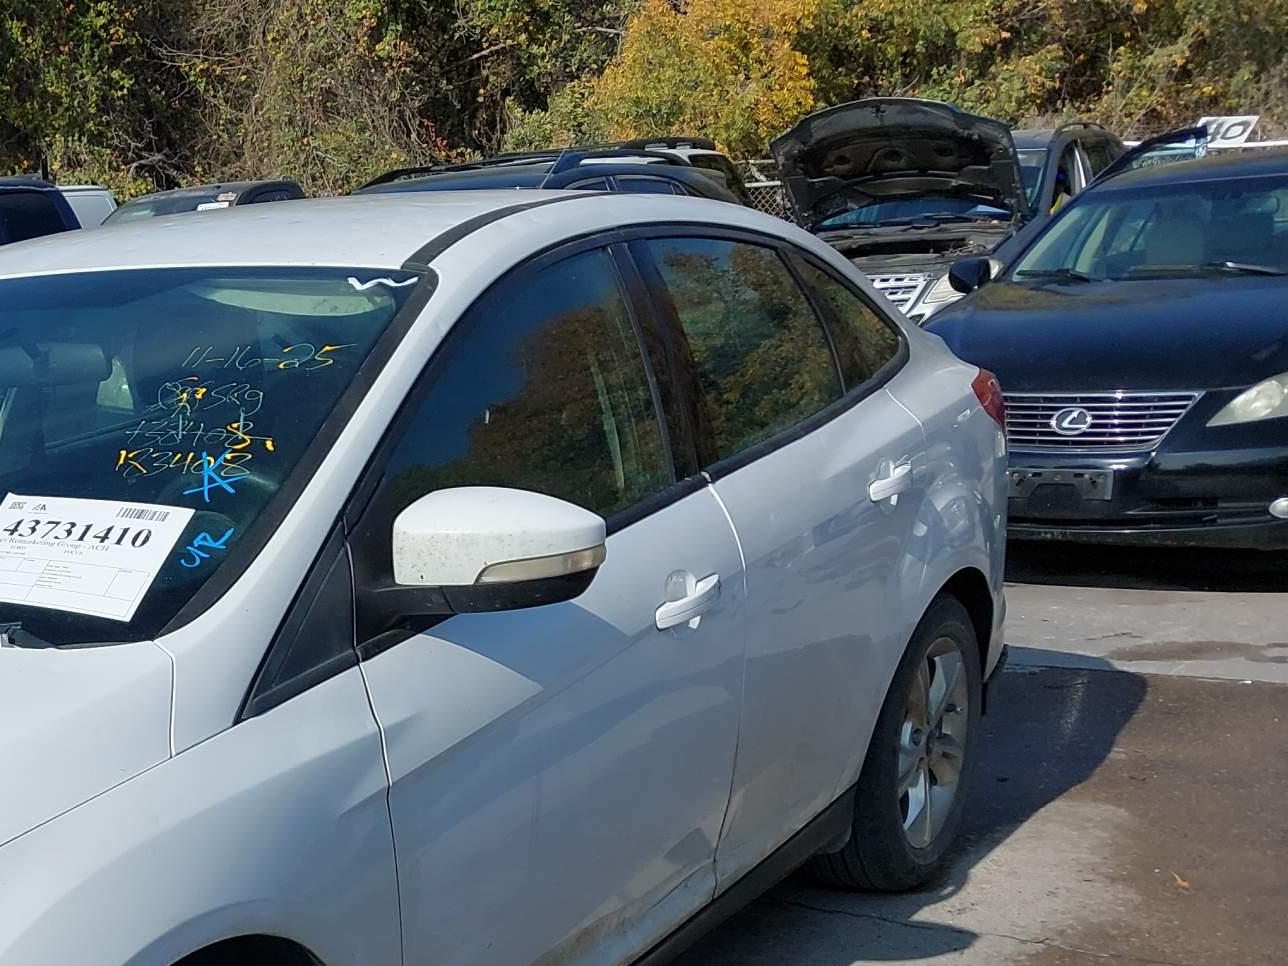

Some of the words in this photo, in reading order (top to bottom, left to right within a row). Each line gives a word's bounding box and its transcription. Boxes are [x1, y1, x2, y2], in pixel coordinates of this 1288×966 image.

[2, 518, 152, 549] 43731410
[8, 537, 55, 547] Remarketing
[57, 540, 82, 552] Group
[88, 544, 110, 552] ACH
